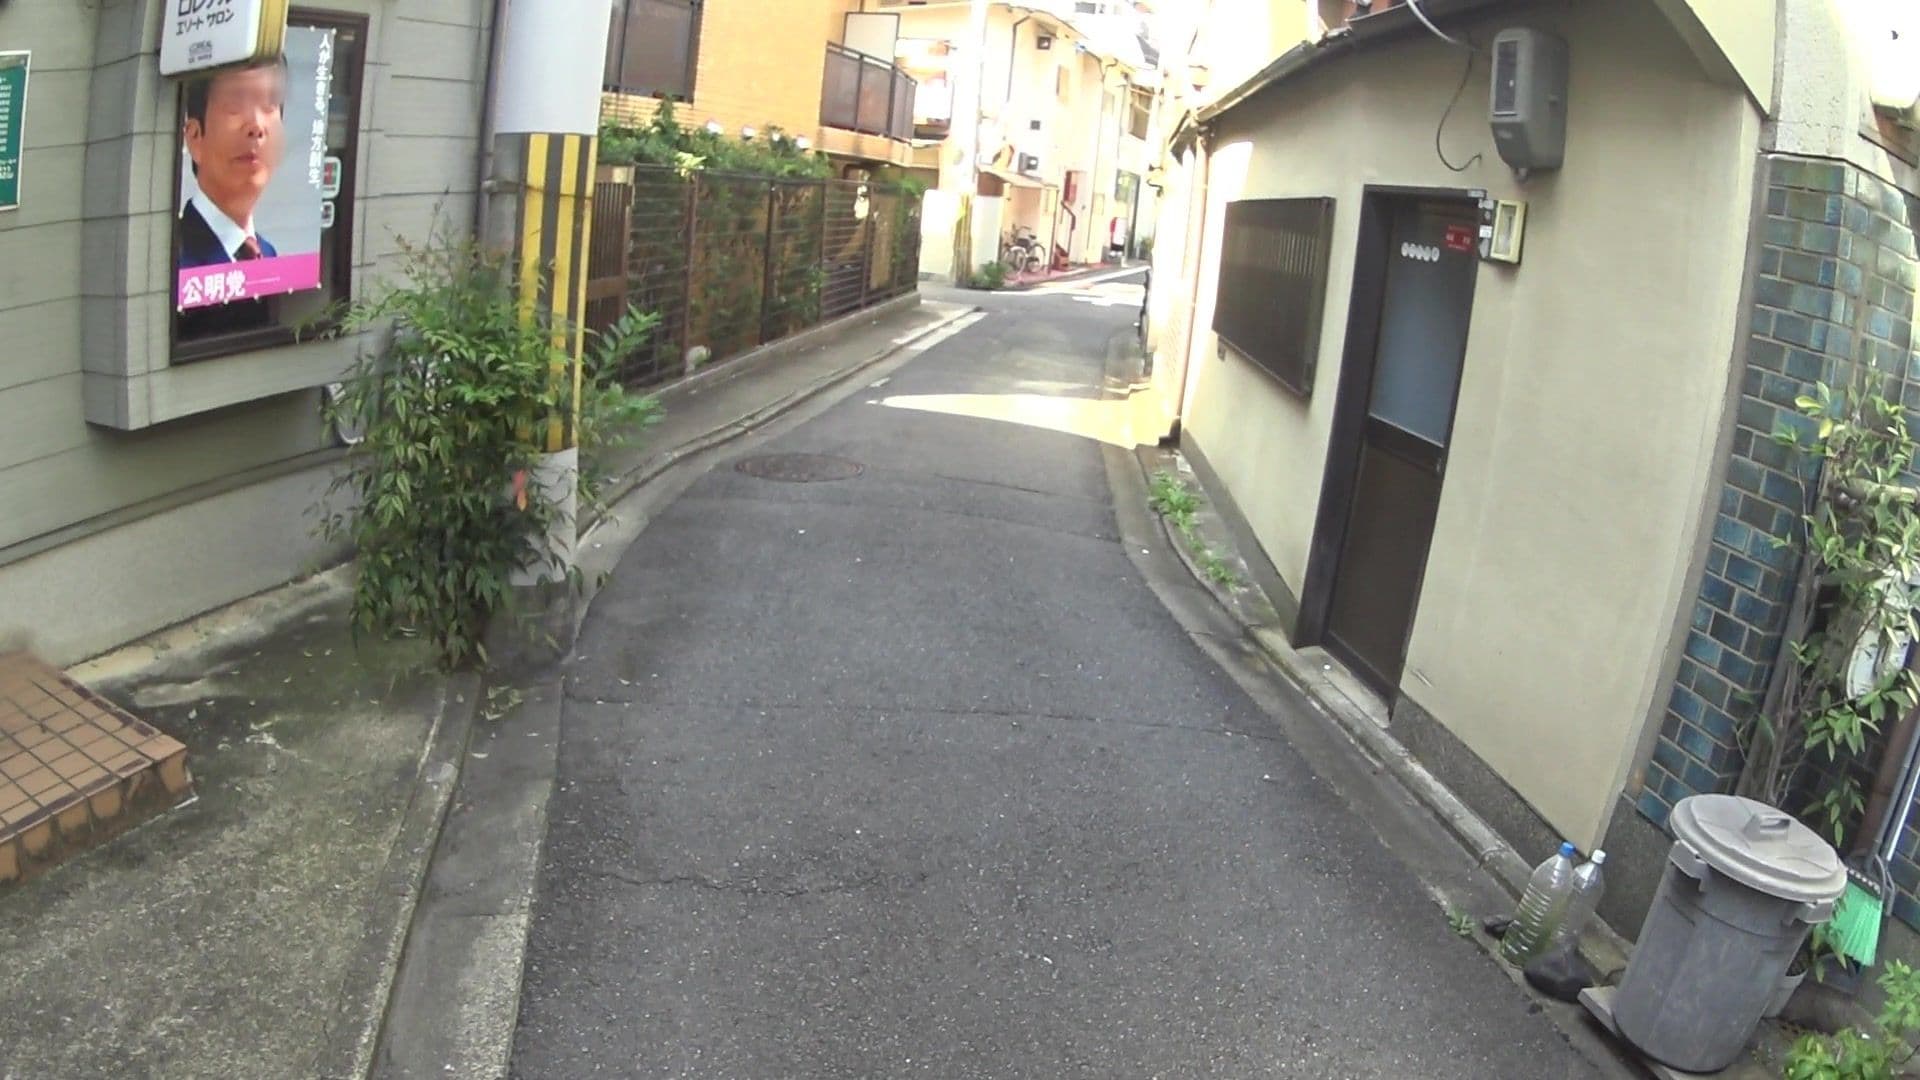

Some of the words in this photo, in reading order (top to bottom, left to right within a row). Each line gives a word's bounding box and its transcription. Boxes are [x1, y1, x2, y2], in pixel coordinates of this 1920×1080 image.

[176, 16, 204, 36] エリート
[206, 8, 235, 28] サロン
[182, 269, 246, 304] 公明党
